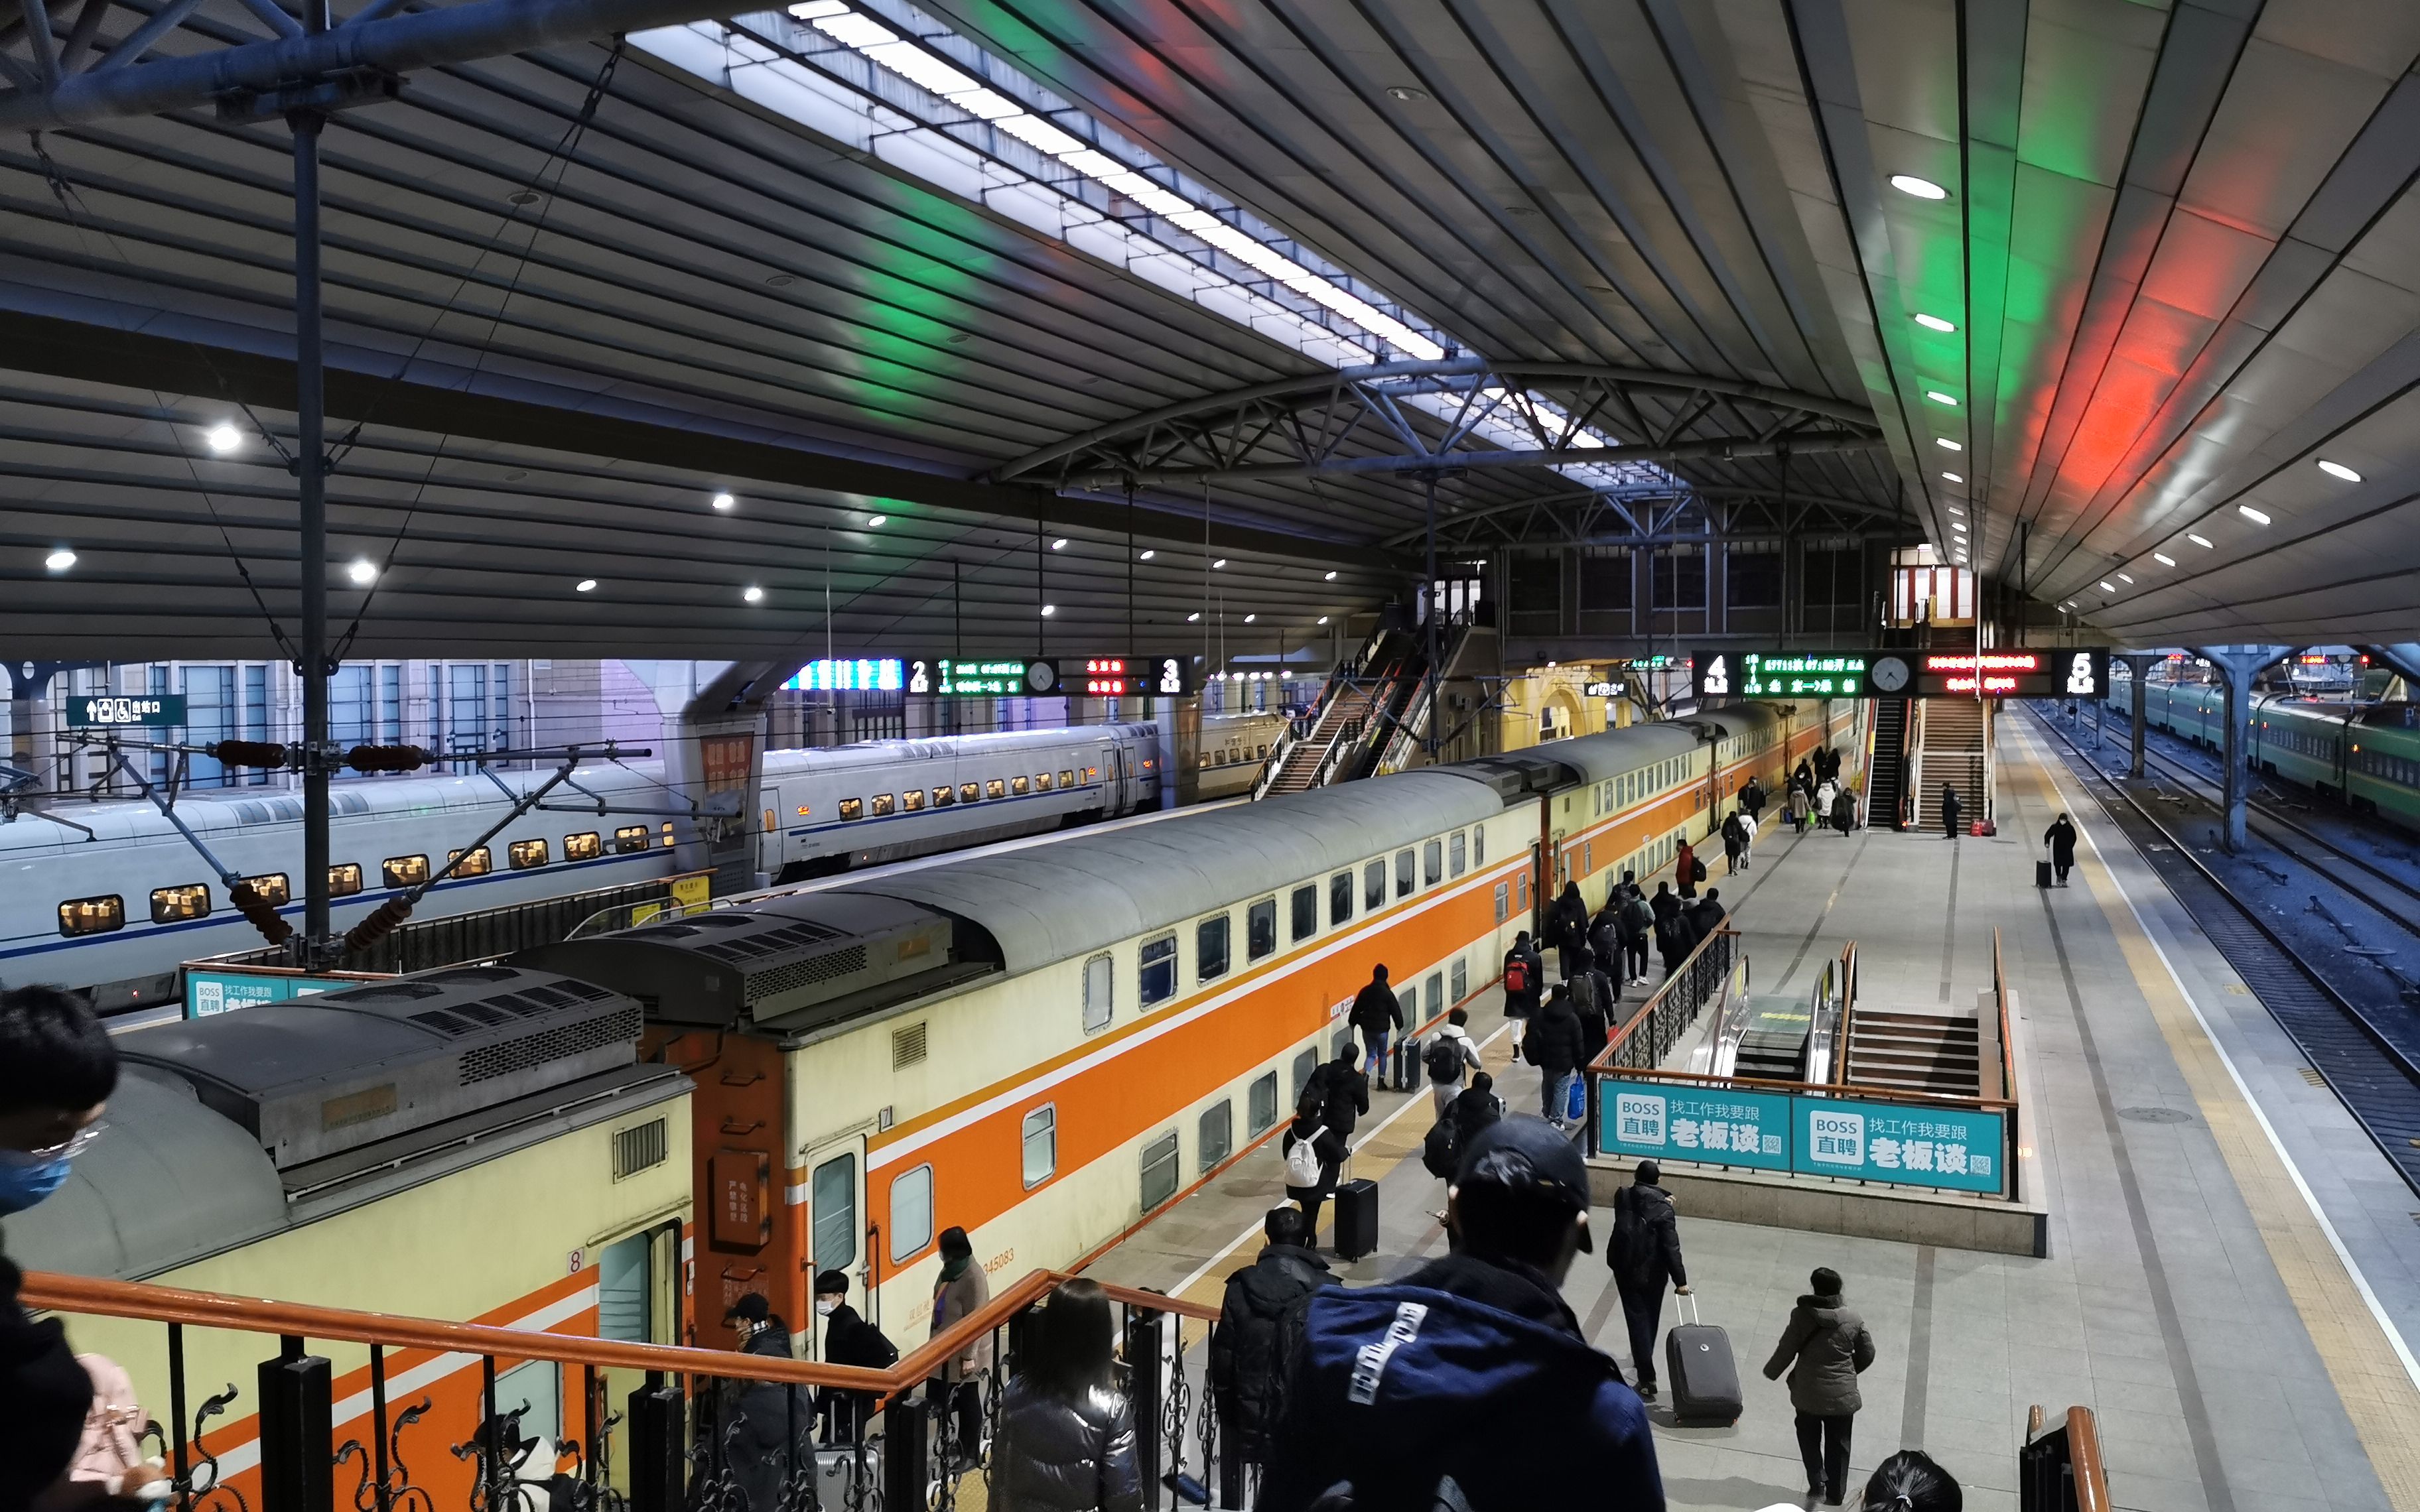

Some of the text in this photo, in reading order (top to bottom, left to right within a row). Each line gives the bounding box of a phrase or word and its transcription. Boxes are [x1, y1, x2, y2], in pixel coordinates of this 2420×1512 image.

[912, 661, 927, 680] 2
[1163, 659, 1178, 680] 3
[1707, 655, 1726, 678] 4
[2071, 653, 2092, 679] 5
[199, 987, 220, 997] BOSS
[225, 985, 272, 997] 找工作我要跟
[200, 999, 220, 1012] 直聘
[882, 1108, 889, 1125] 7
[1623, 1102, 1660, 1116] BOSS
[1670, 1100, 1760, 1121] 找工作我要跟
[1623, 1117, 1660, 1137] 直聘
[1670, 1117, 1761, 1154] 老板谈
[1816, 1119, 1858, 1134] BOSS
[1869, 1117, 1968, 1141] 找工作我要跟
[1816, 1135, 1858, 1157] 直聘
[1868, 1137, 1969, 1175] 老板谈
[571, 1251, 580, 1273] 8
